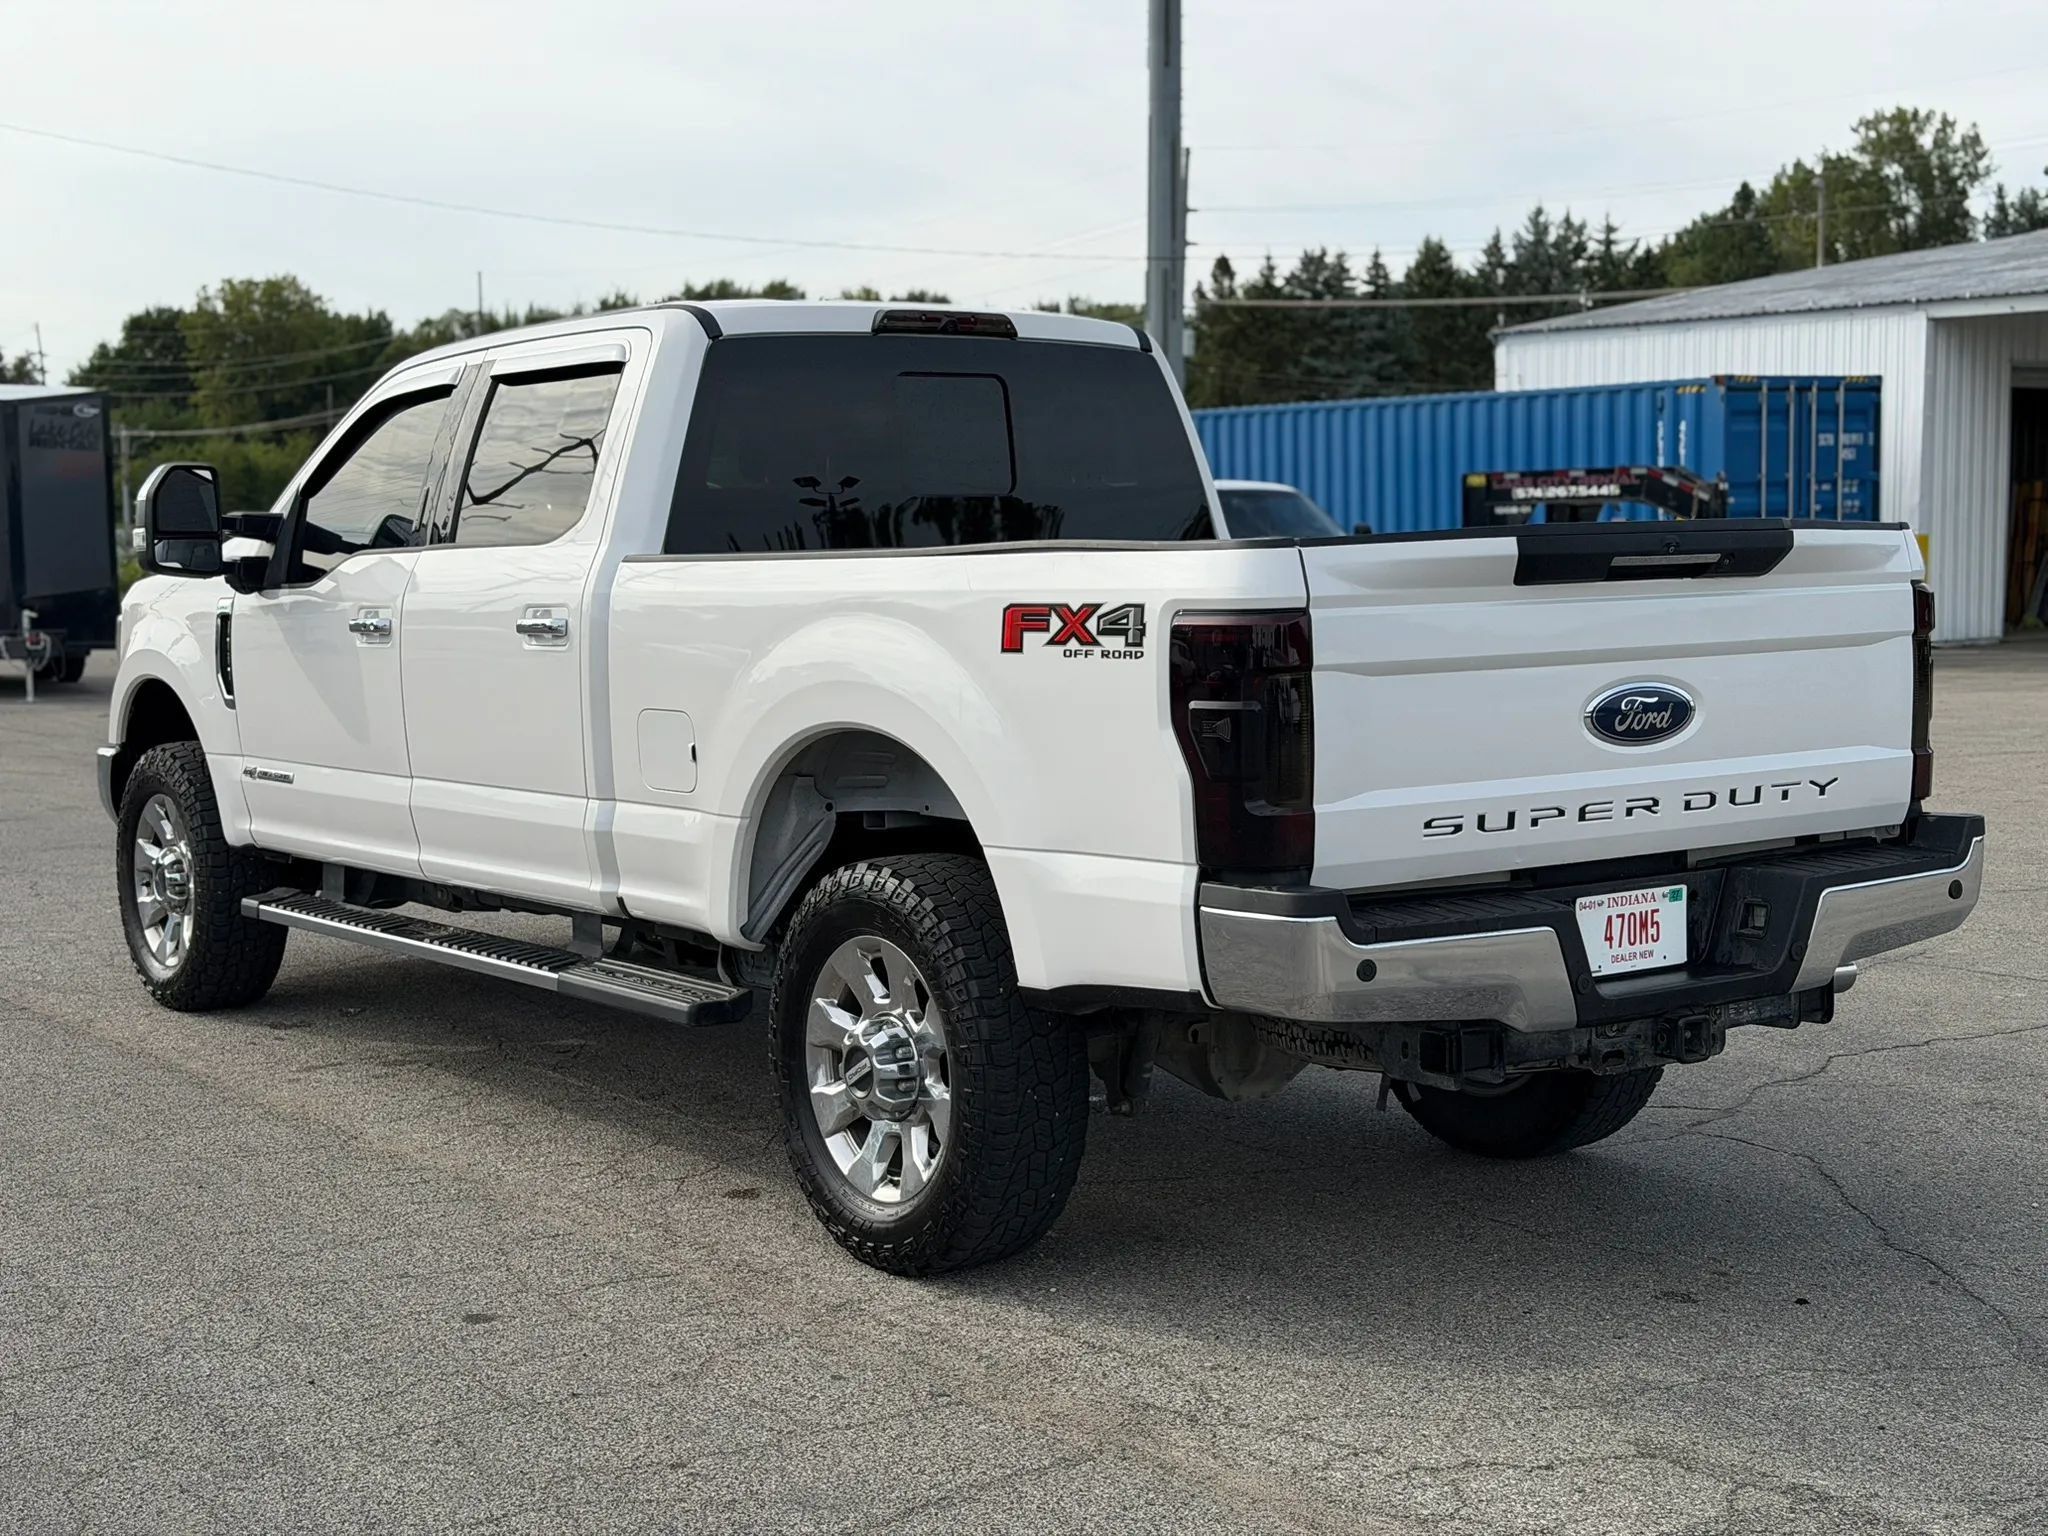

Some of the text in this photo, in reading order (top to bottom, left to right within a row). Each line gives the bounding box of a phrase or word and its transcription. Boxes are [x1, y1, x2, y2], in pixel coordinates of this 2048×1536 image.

[1000, 602, 1146, 653] FX4
[1063, 649, 1144, 660] OFF ROAD
[1615, 696, 1674, 732] Ford
[1422, 776, 1839, 839] SUPER DUTY
[1607, 892, 1656, 908] INDIANA
[1604, 908, 1660, 949] 470M5
[1611, 949, 1654, 964] DEALER NEW
